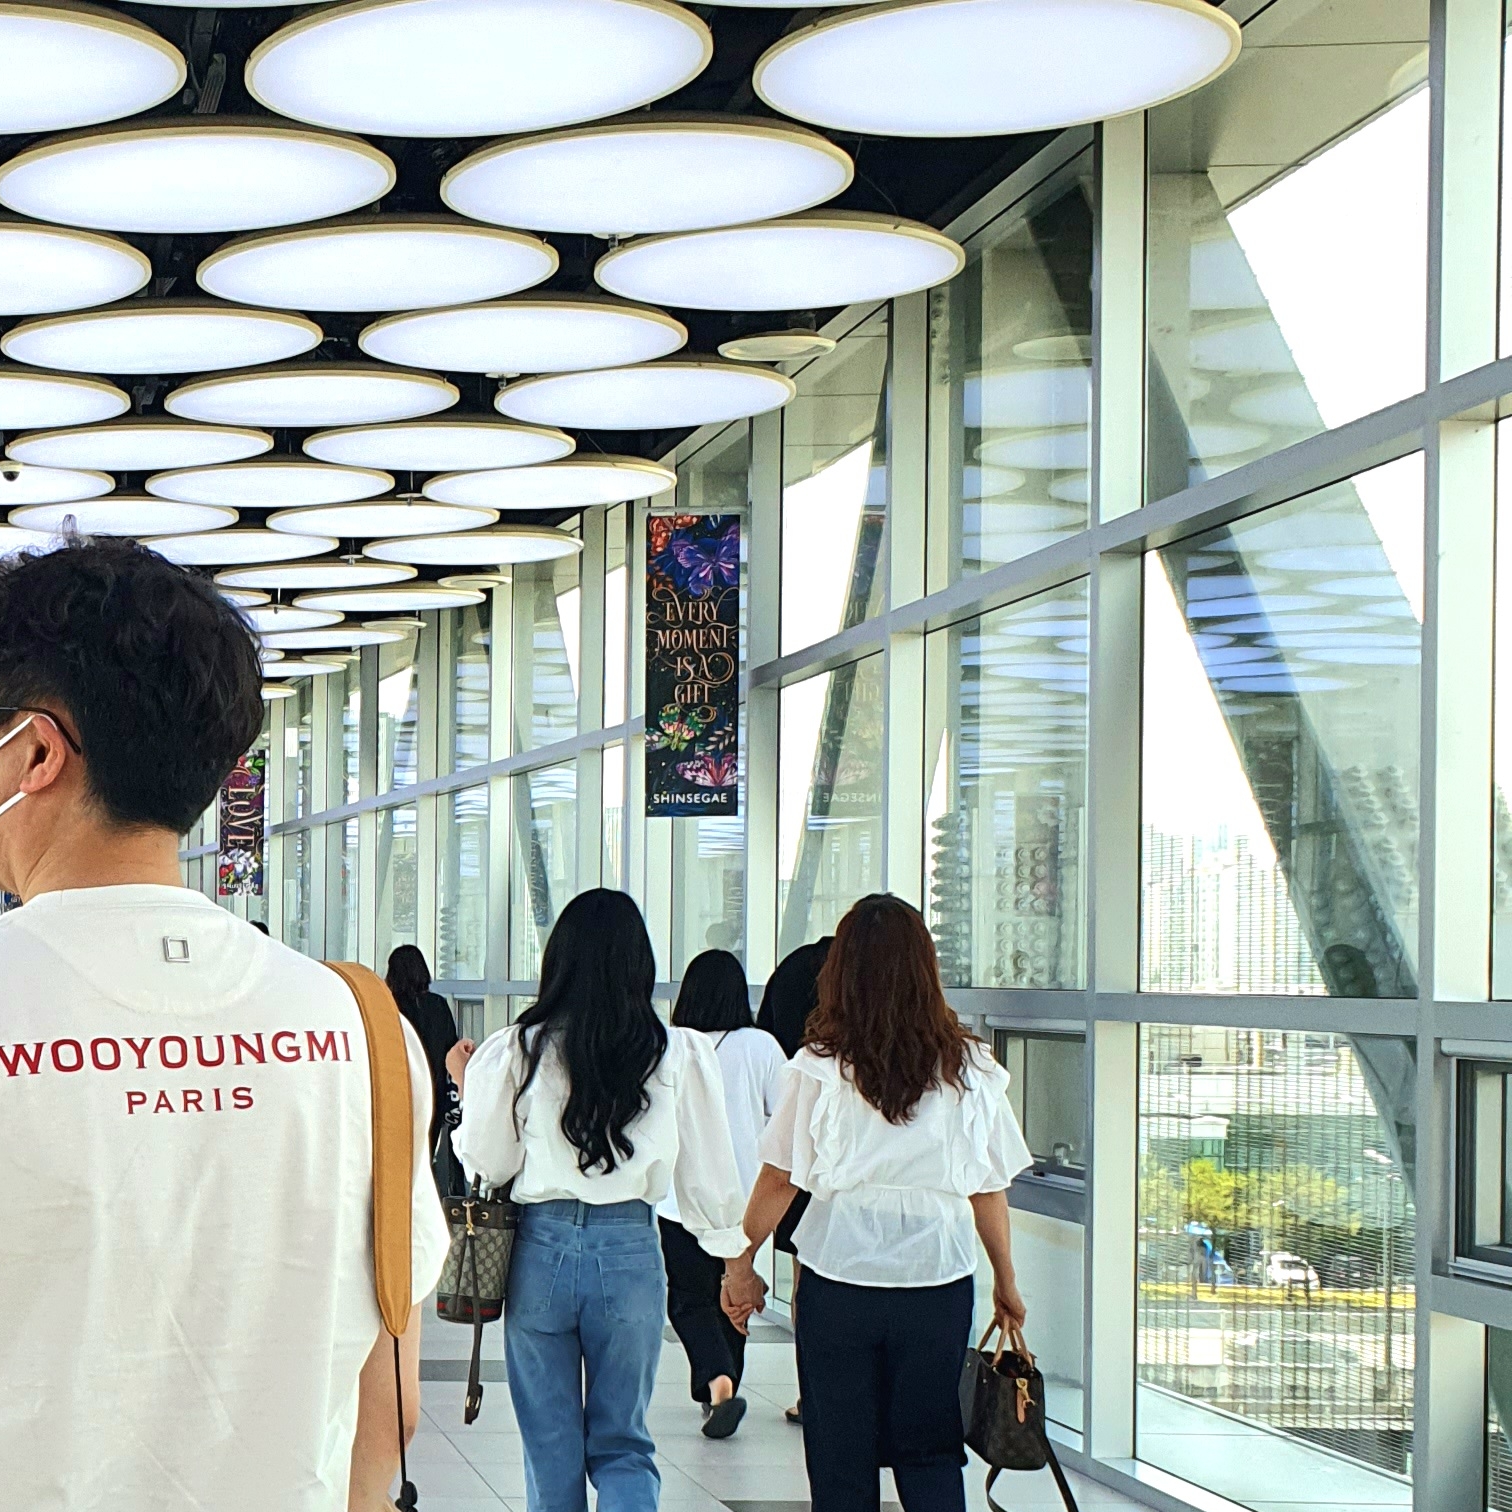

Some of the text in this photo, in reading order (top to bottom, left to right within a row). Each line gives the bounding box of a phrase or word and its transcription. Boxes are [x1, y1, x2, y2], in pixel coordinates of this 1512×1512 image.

[658, 596, 728, 626] EVERY
[654, 623, 734, 651] MOMENT
[675, 656, 694, 681] IS
[674, 684, 709, 704] GIFT
[653, 793, 728, 804] SHINSEGAE
[227, 786, 259, 848] LOVE
[125, 1087, 255, 1115] PARIS
